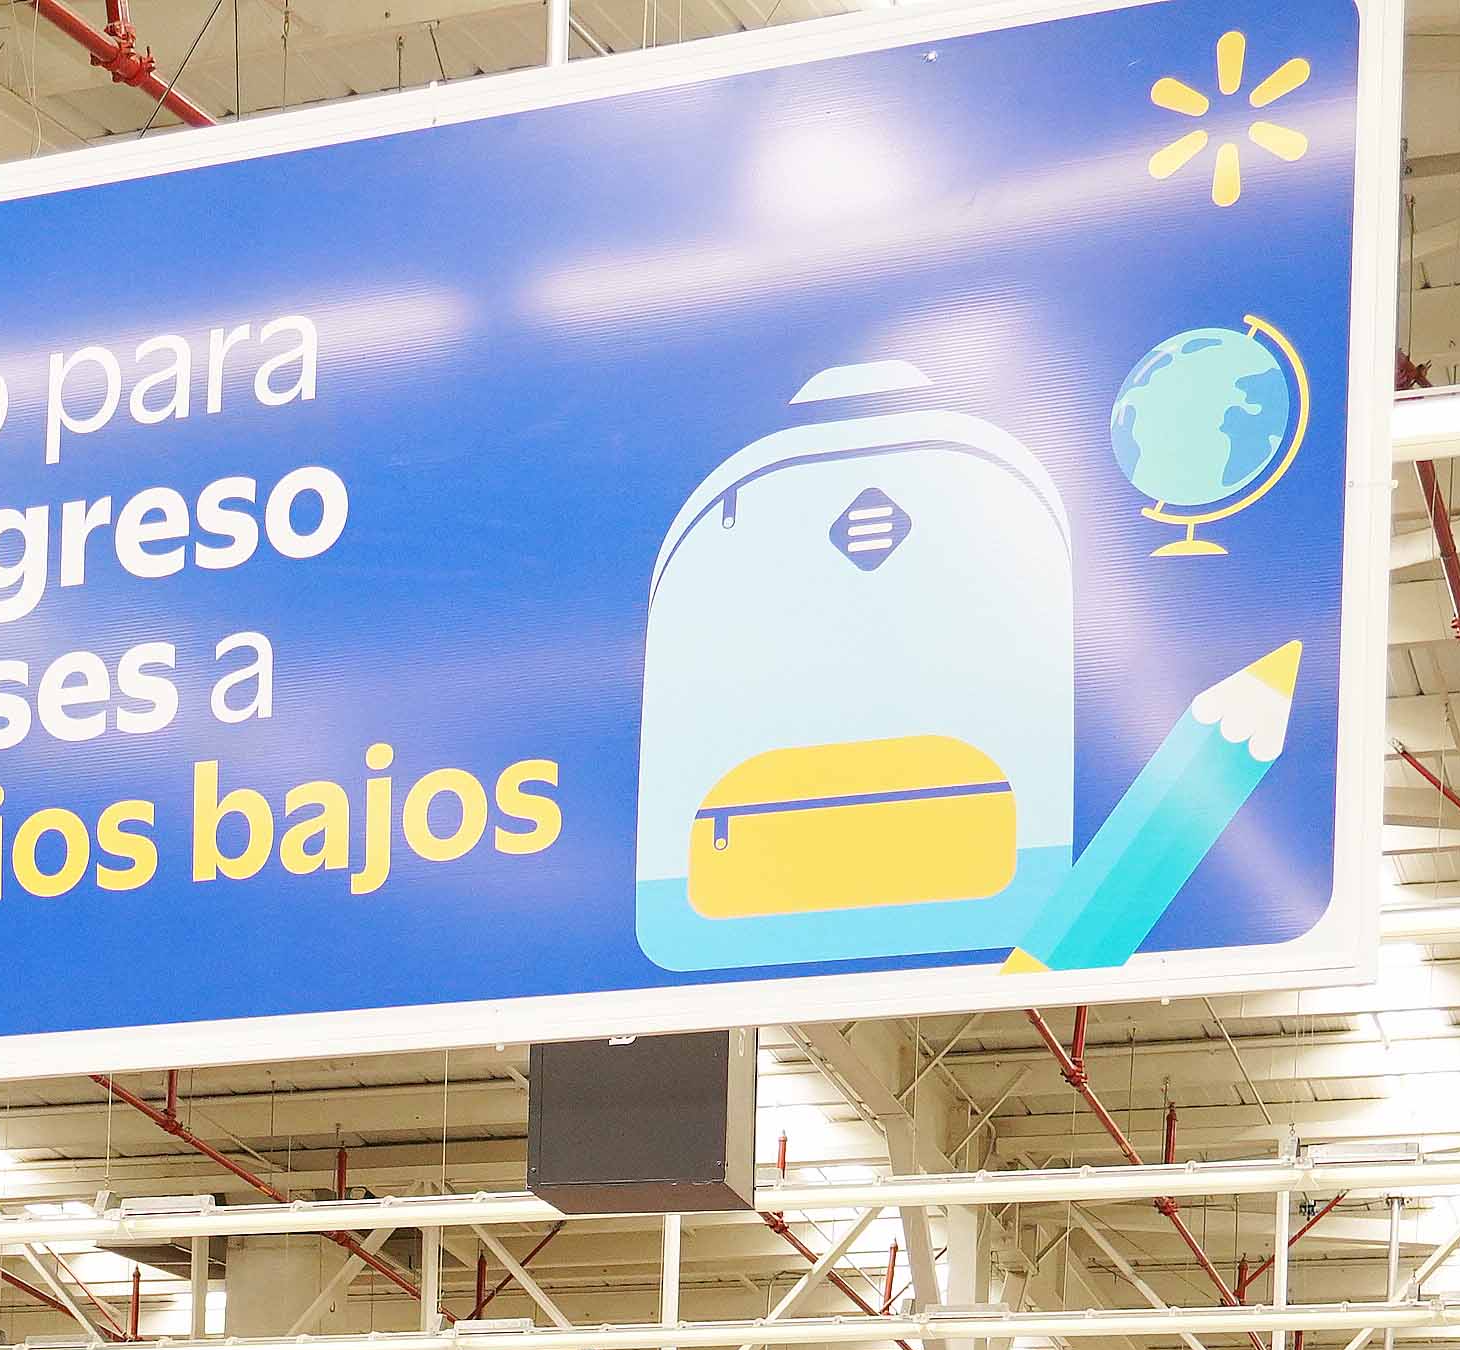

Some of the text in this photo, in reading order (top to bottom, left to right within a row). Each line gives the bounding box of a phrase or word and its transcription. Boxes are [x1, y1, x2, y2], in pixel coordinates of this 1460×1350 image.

[43, 309, 318, 465] para
[211, 631, 273, 723] a
[193, 742, 563, 894] bajos
